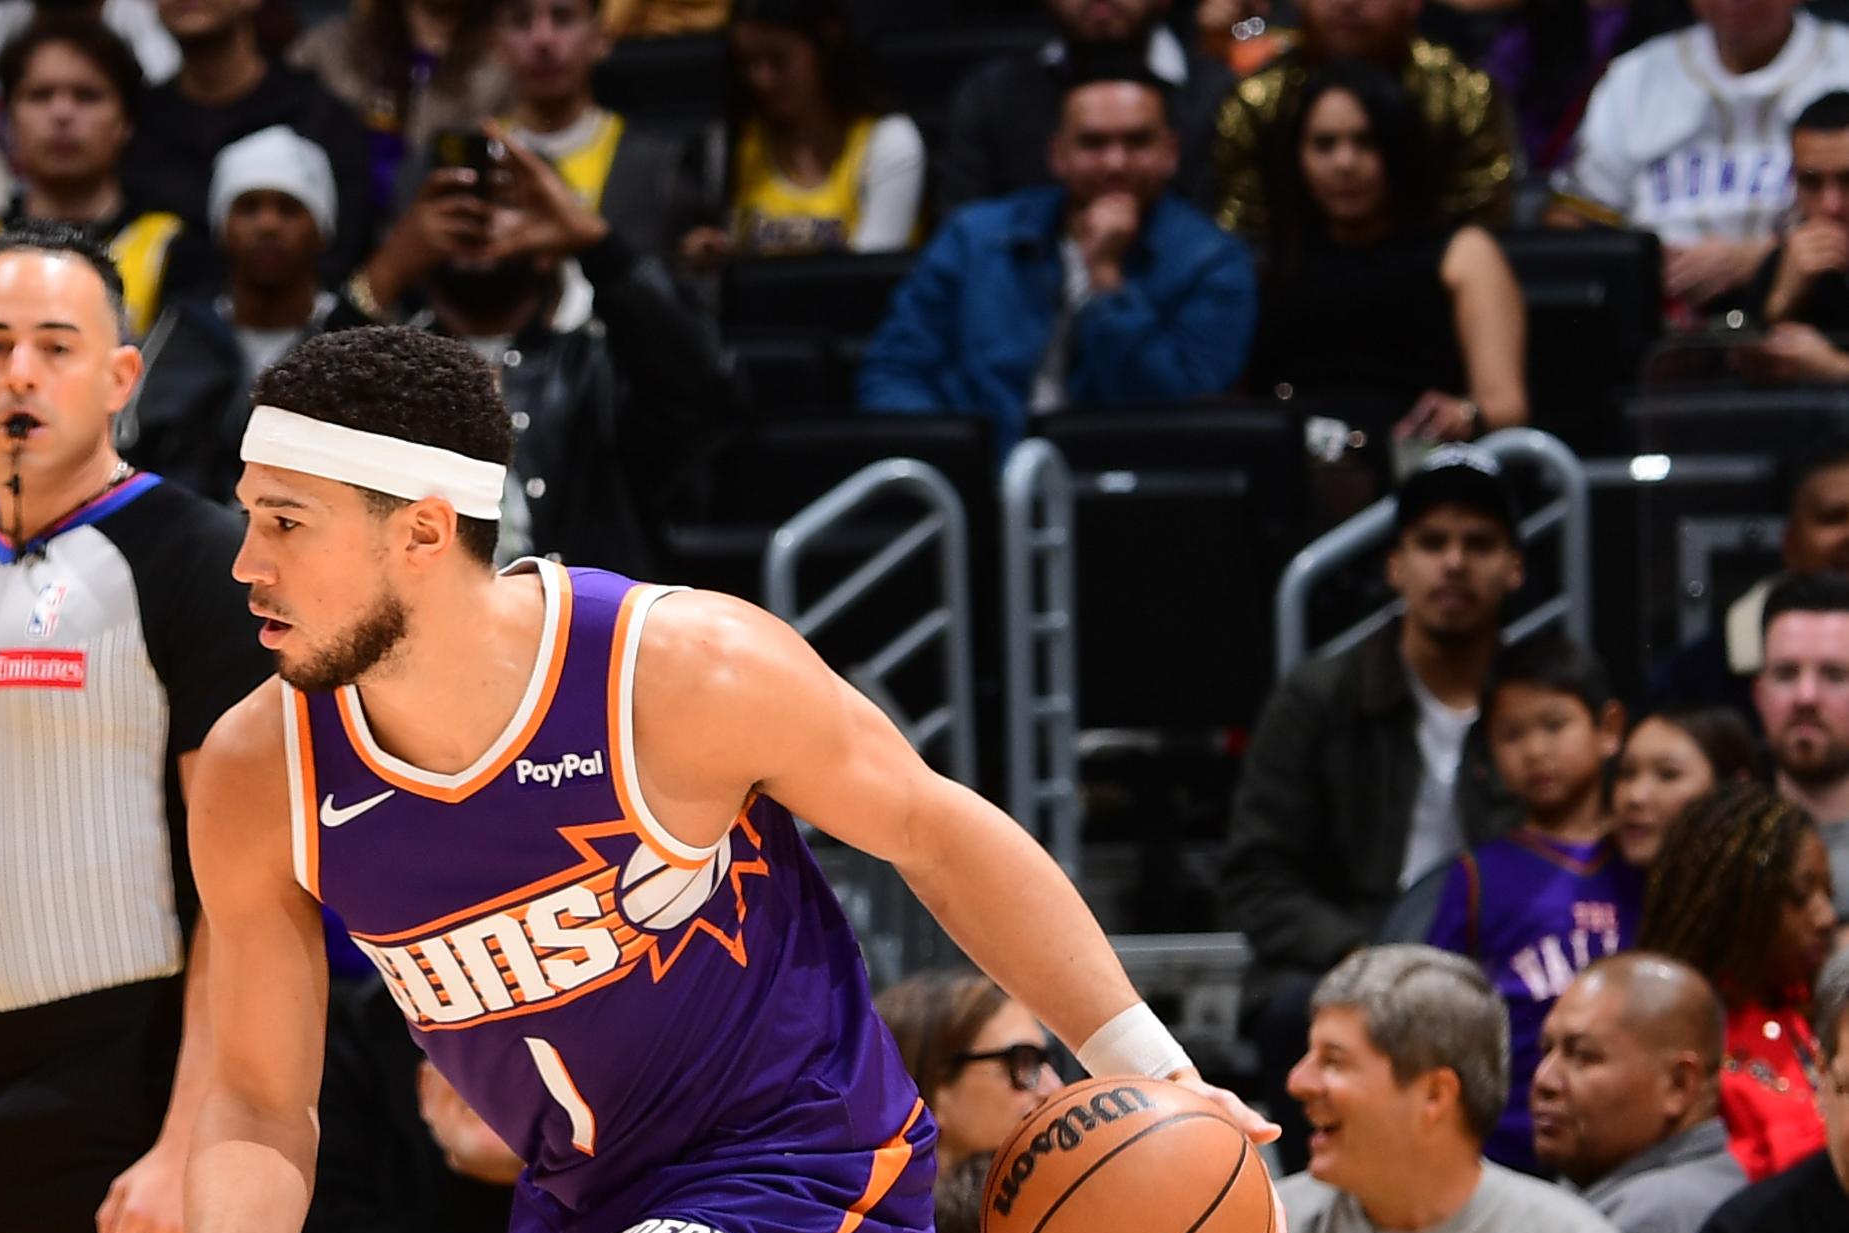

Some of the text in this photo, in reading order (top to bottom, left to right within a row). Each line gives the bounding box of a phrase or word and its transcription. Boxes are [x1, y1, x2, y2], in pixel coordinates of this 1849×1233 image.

[515, 750, 604, 788] PayPal
[523, 1036, 597, 1157] 1
[994, 1086, 1156, 1216] Wilson
